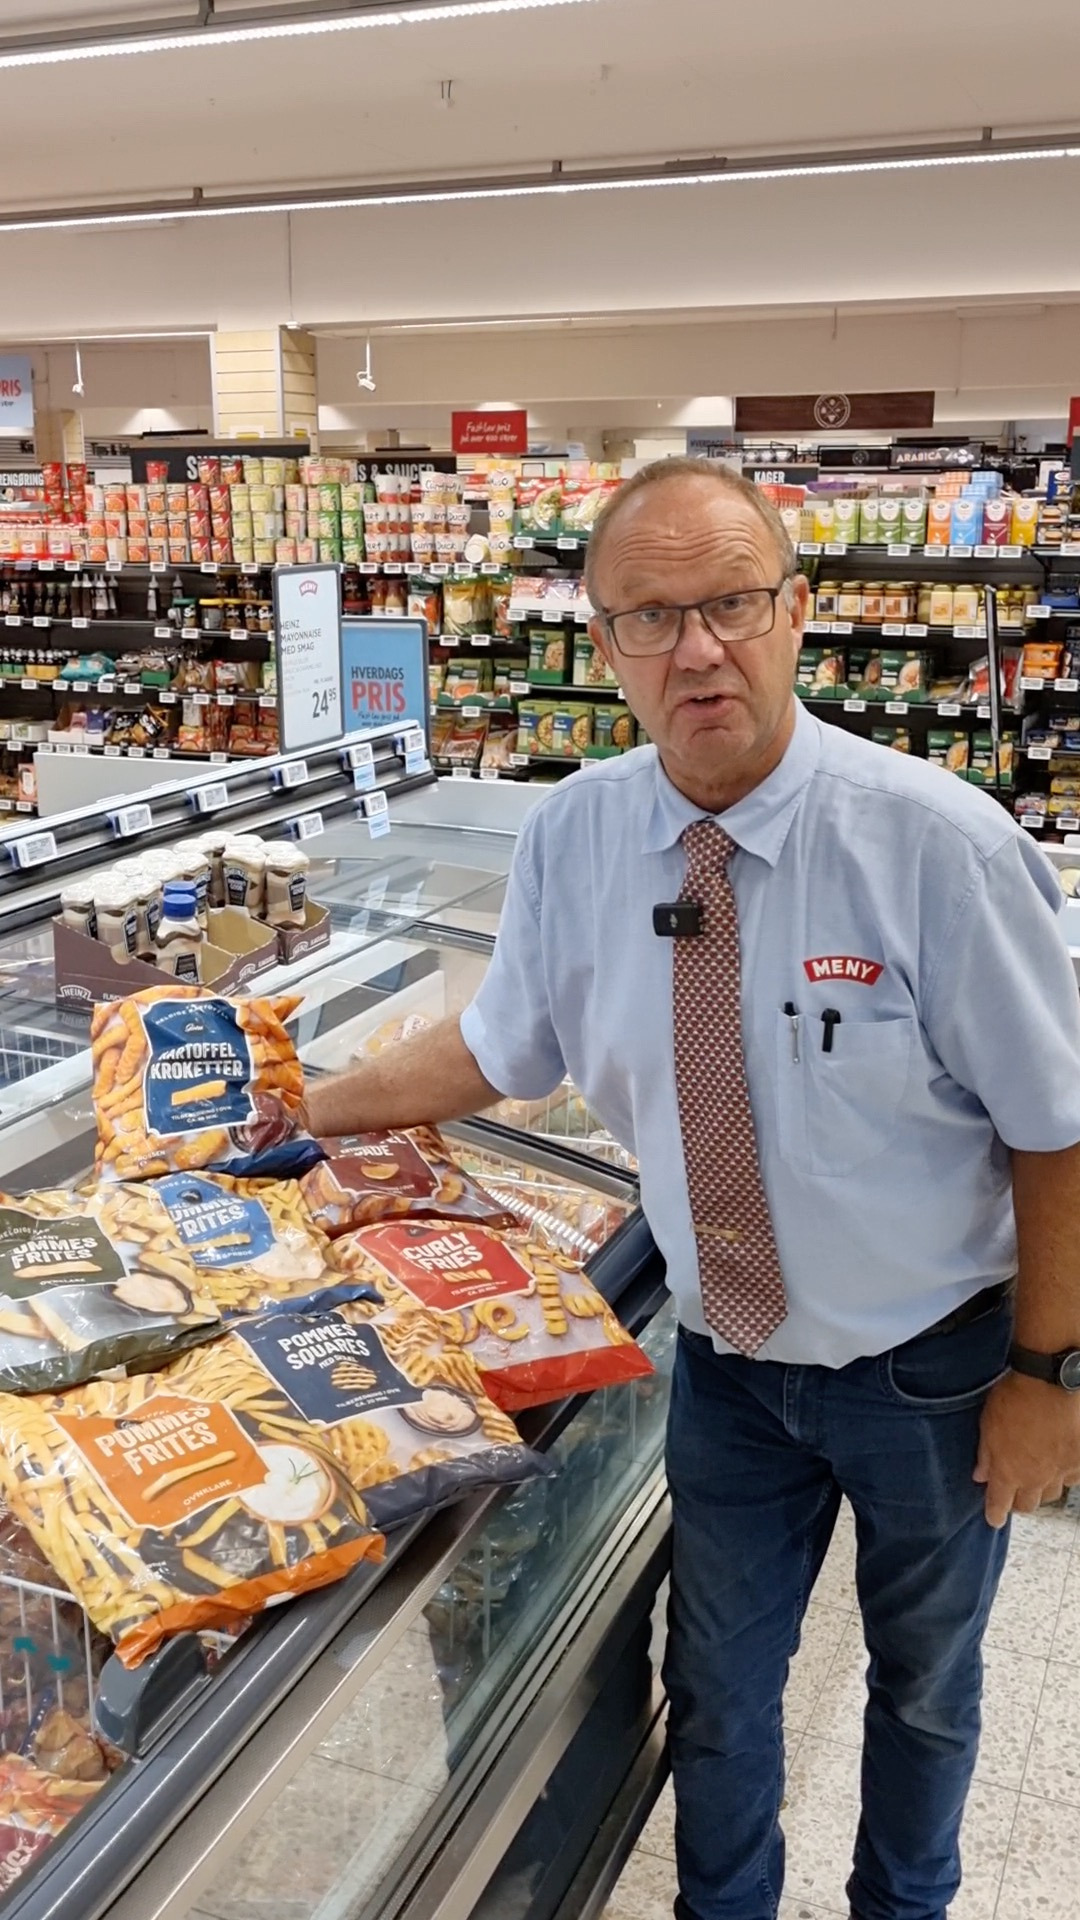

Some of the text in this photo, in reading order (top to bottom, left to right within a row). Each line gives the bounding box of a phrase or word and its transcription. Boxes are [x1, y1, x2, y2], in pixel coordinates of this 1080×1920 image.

[896, 451, 942, 463] ARABICA
[754, 471, 785, 484] KAGER
[281, 620, 299, 630] HEINZ
[281, 629, 322, 643] MAYONNAISE
[281, 643, 315, 656] MED SMAG
[351, 666, 404, 680] HVERDAGS
[352, 681, 406, 712] PRIS
[812, 959, 875, 979] MENY
[63, 987, 88, 999] HEINZ
[149, 1059, 245, 1080] KROKETTER
[402, 1231, 470, 1260] CURLY
[11, 1249, 93, 1270] FRITES
[417, 1245, 484, 1271] FRIES
[277, 1323, 358, 1352] POMMES
[286, 1338, 371, 1370] SQUARES
[318, 1356, 336, 1369] MED
[94, 1405, 212, 1458] POMMES
[122, 1421, 218, 1476] FRITES
[183, 1478, 233, 1507] OVNKLARE
